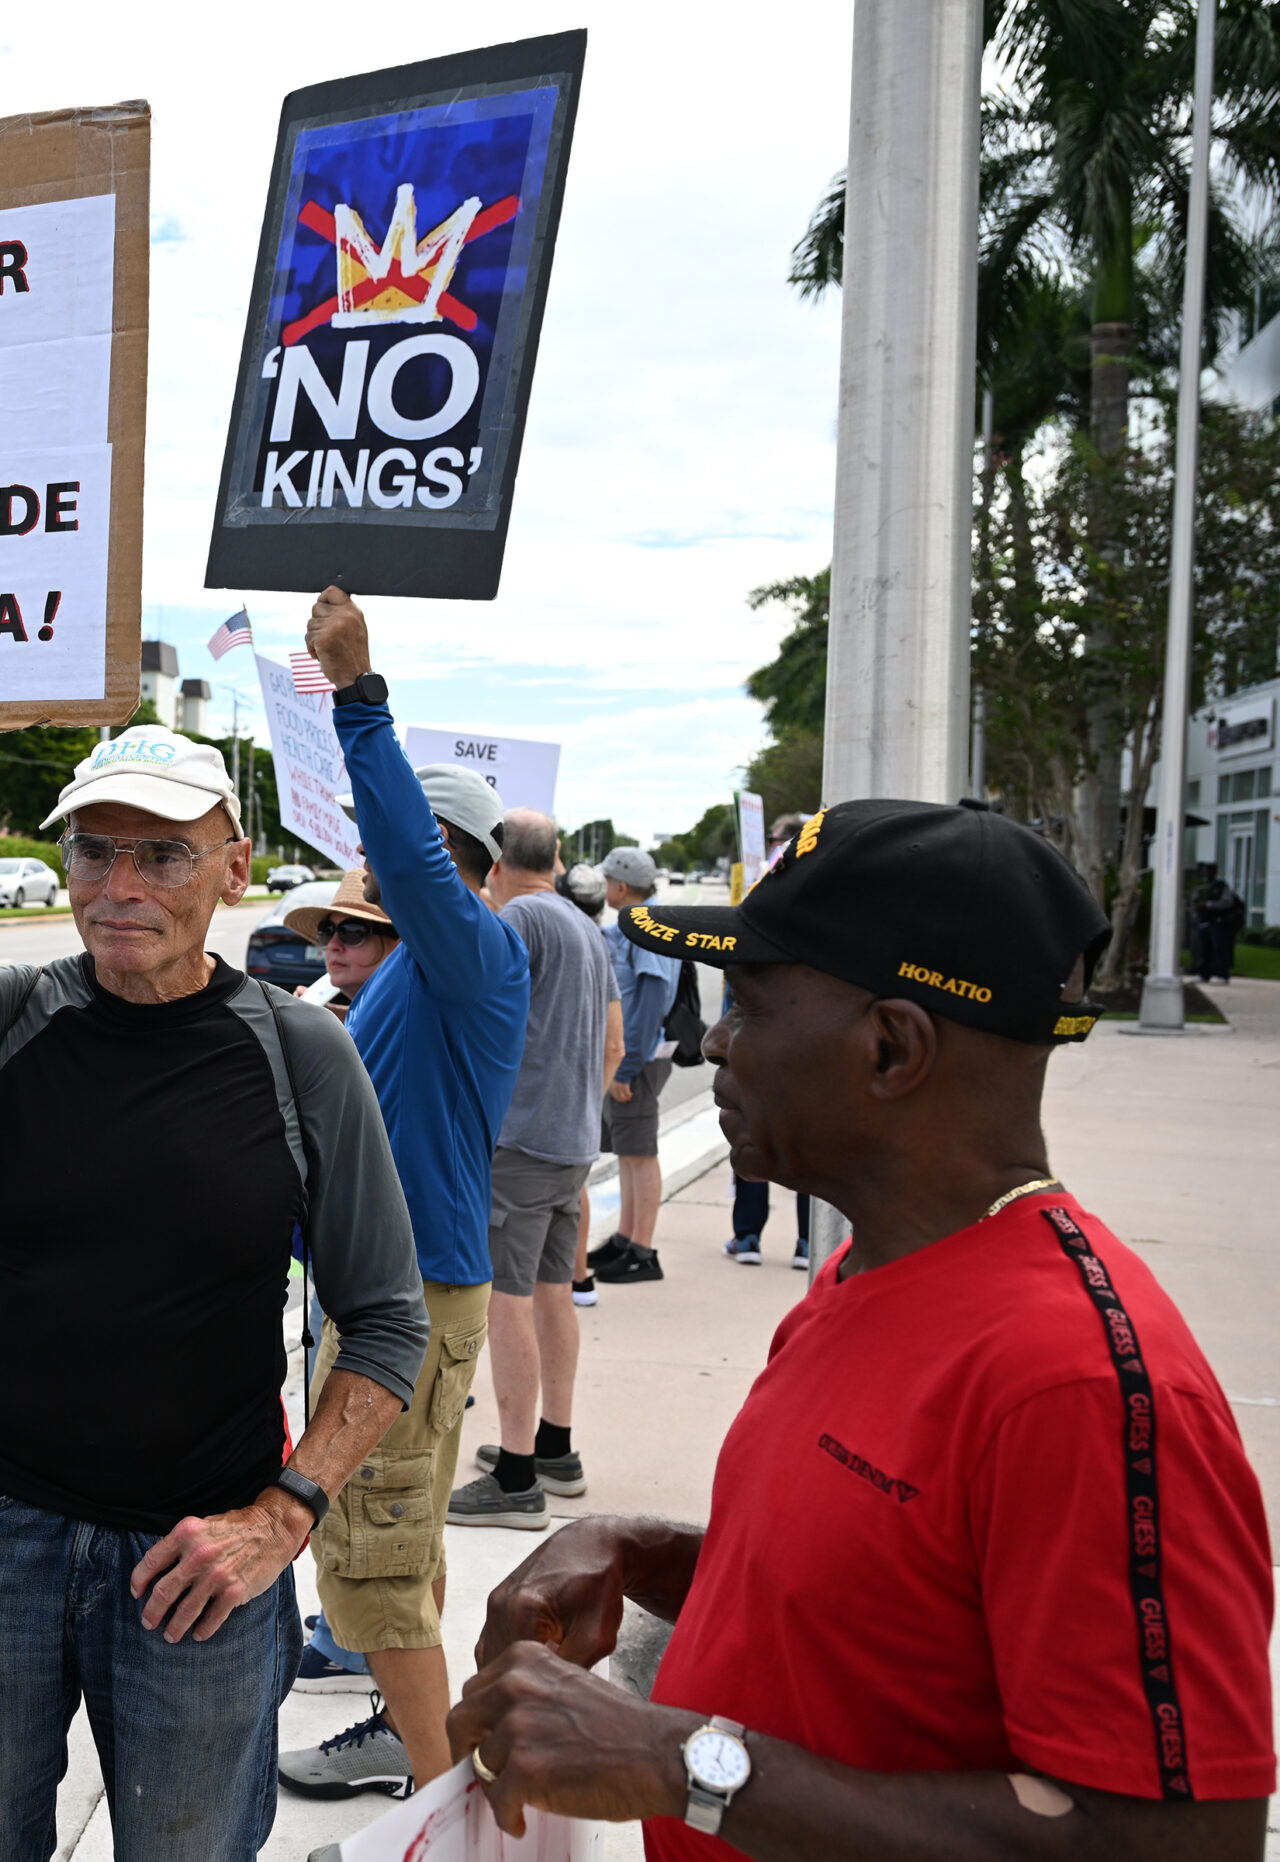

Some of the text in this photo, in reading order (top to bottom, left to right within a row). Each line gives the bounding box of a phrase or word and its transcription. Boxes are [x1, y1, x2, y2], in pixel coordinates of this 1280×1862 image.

[276, 702, 336, 758] FOOD PRICES
[454, 740, 498, 761] SAVE
[685, 932, 737, 951] STAR
[897, 962, 993, 1003] HORATIO
[1106, 1308, 1136, 1355] GUESS
[1129, 1393, 1151, 1451] GUESS
[1133, 1496, 1156, 1556] GUESS
[1140, 1597, 1167, 1660] GUESS
[1157, 1703, 1184, 1769] GUESS
